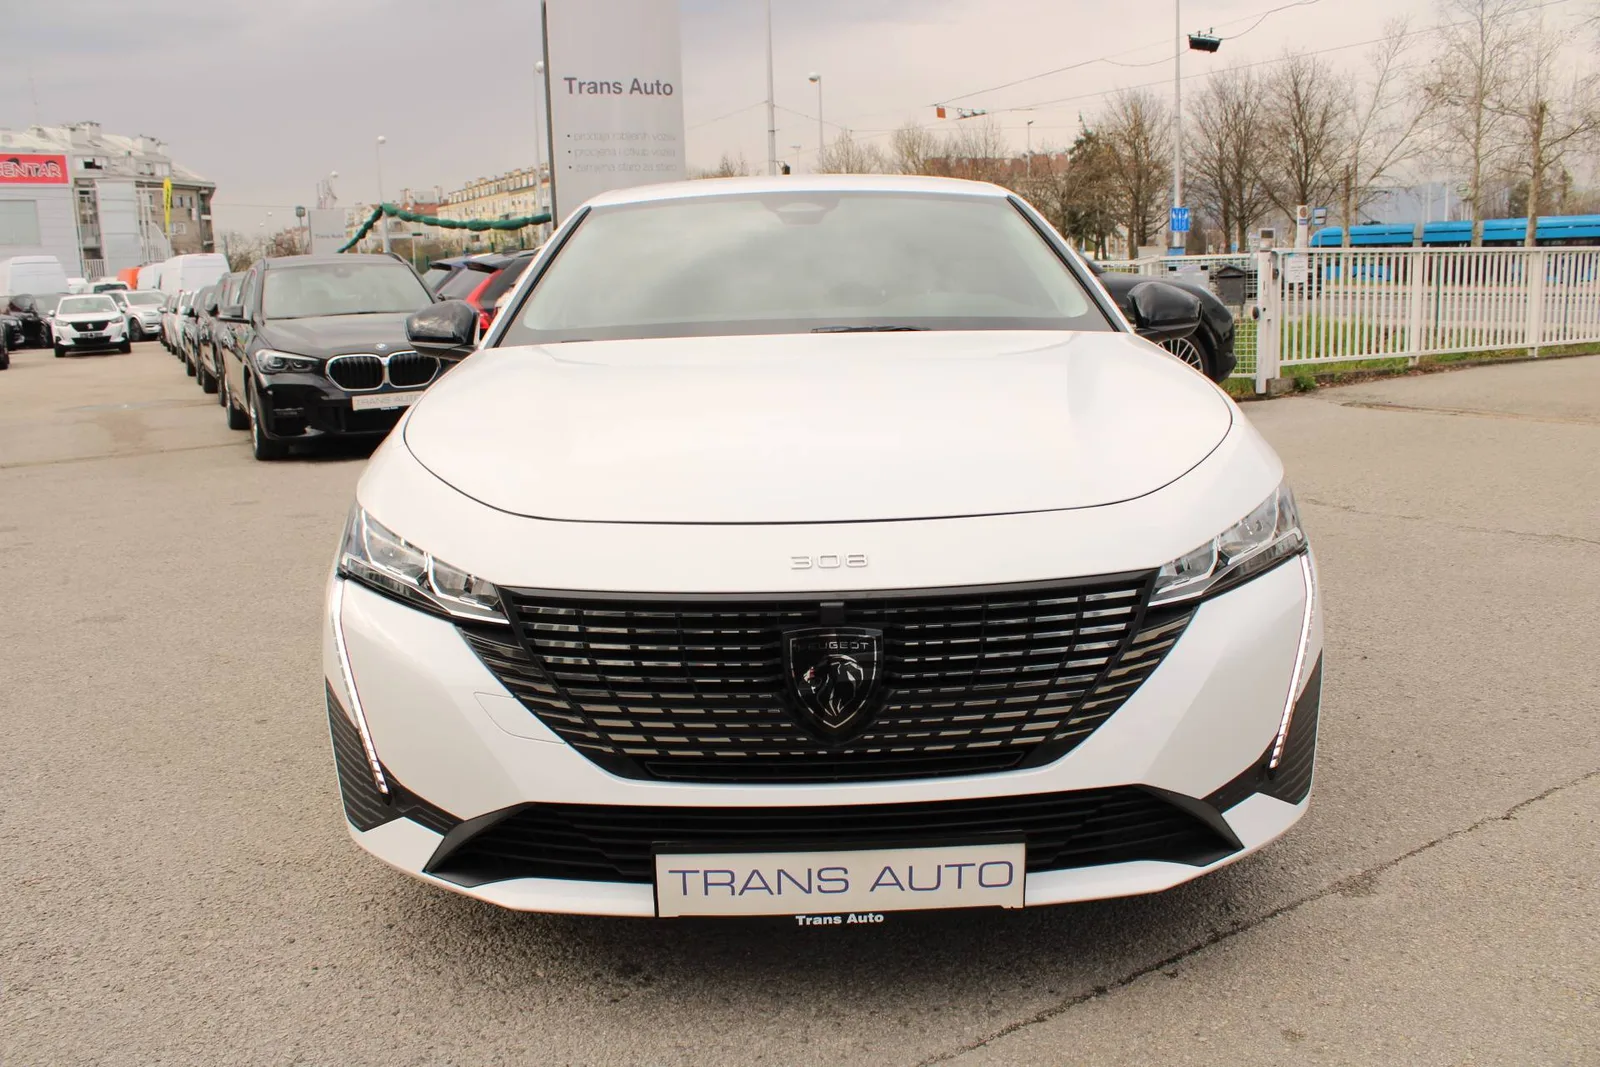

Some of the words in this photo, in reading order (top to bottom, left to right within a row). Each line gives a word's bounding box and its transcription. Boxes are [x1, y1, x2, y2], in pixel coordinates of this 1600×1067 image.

[563, 77, 623, 95] Trans
[629, 78, 673, 96] Auto
[790, 554, 868, 570] 308
[796, 641, 869, 650] EUGEOT
[668, 867, 849, 896] TRANS
[869, 861, 1014, 892] AUTO
[795, 914, 842, 926] Trans
[847, 912, 884, 925] Auto
